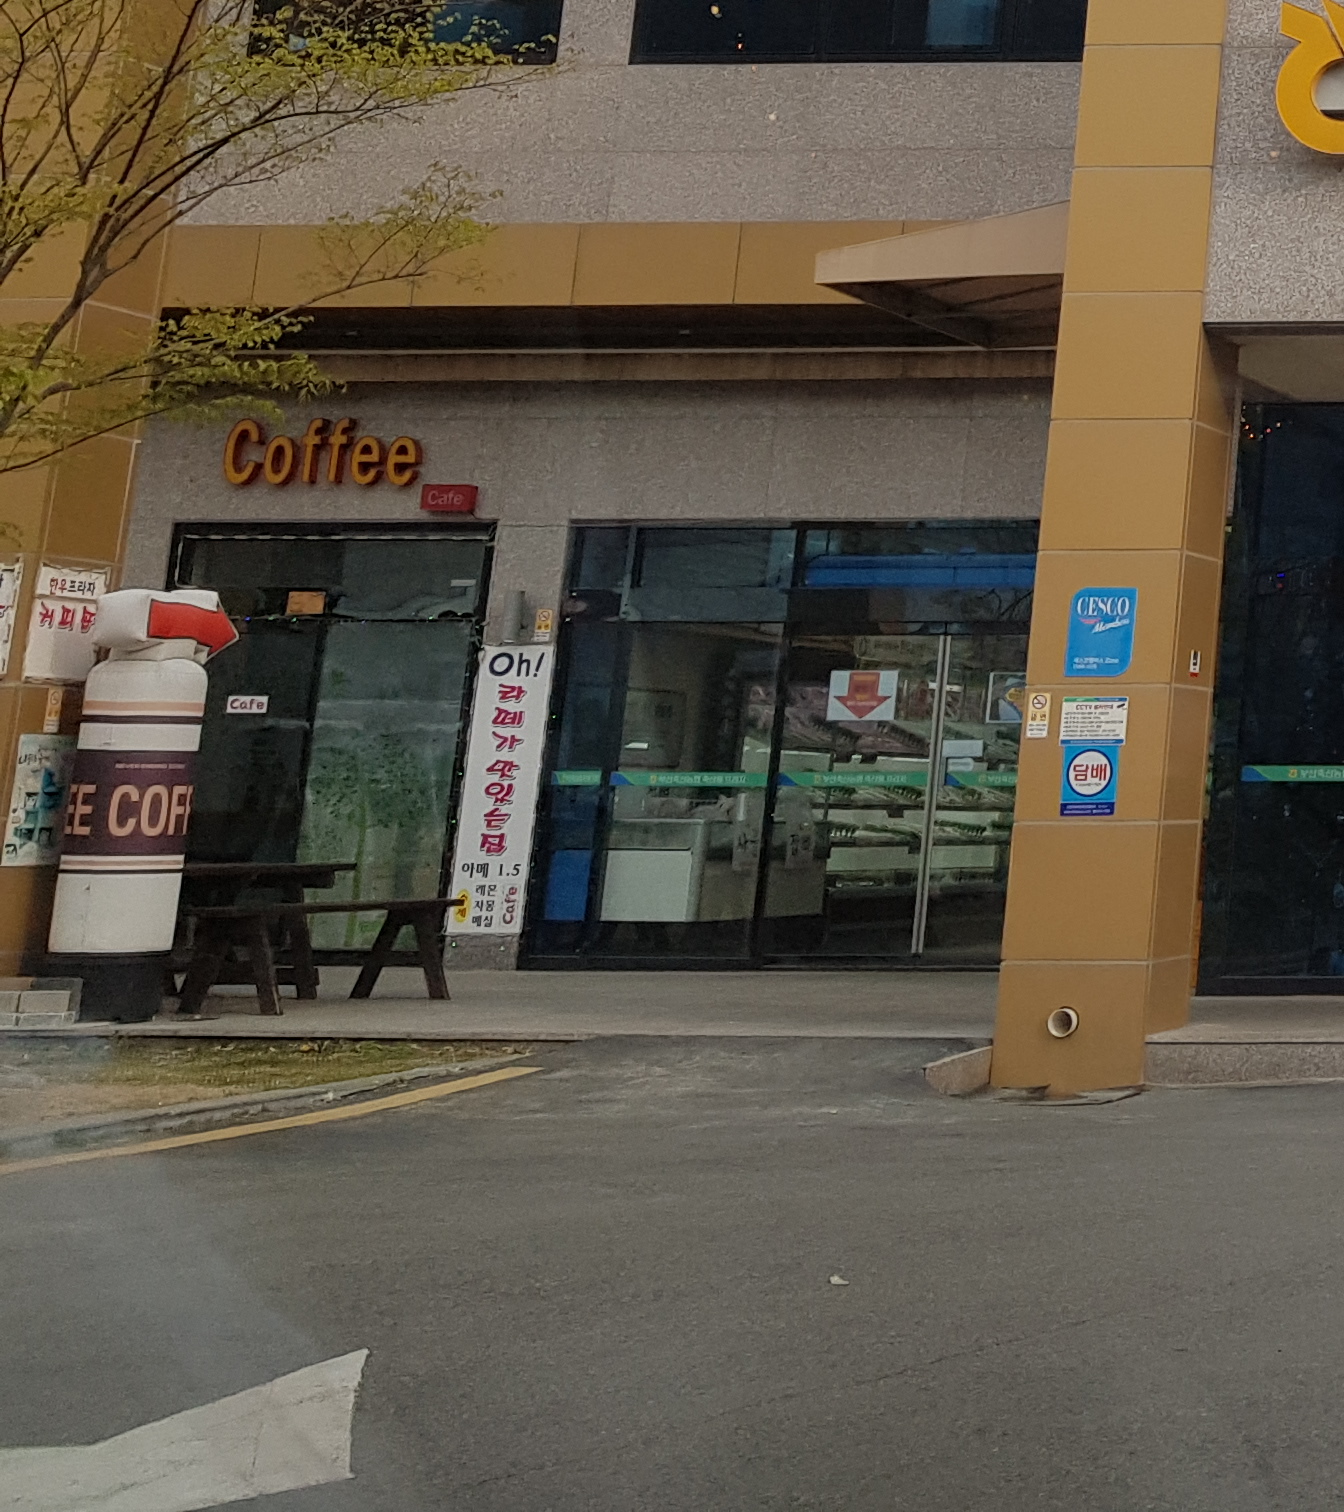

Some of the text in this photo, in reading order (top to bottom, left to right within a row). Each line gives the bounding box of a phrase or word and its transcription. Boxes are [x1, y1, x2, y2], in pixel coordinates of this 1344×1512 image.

[223, 418, 423, 486] Coffee
[427, 490, 464, 506] Cafe
[50, 576, 96, 596] 한우프라자
[1077, 596, 1130, 616] CESCO
[489, 652, 546, 678] Oh!
[229, 698, 265, 711] Cafe
[1072, 763, 1107, 782] 담배
[461, 863, 522, 879] 아메 1.5
[475, 884, 497, 897] 레몬
[474, 900, 495, 912] 자몽
[502, 886, 518, 925] Cafe
